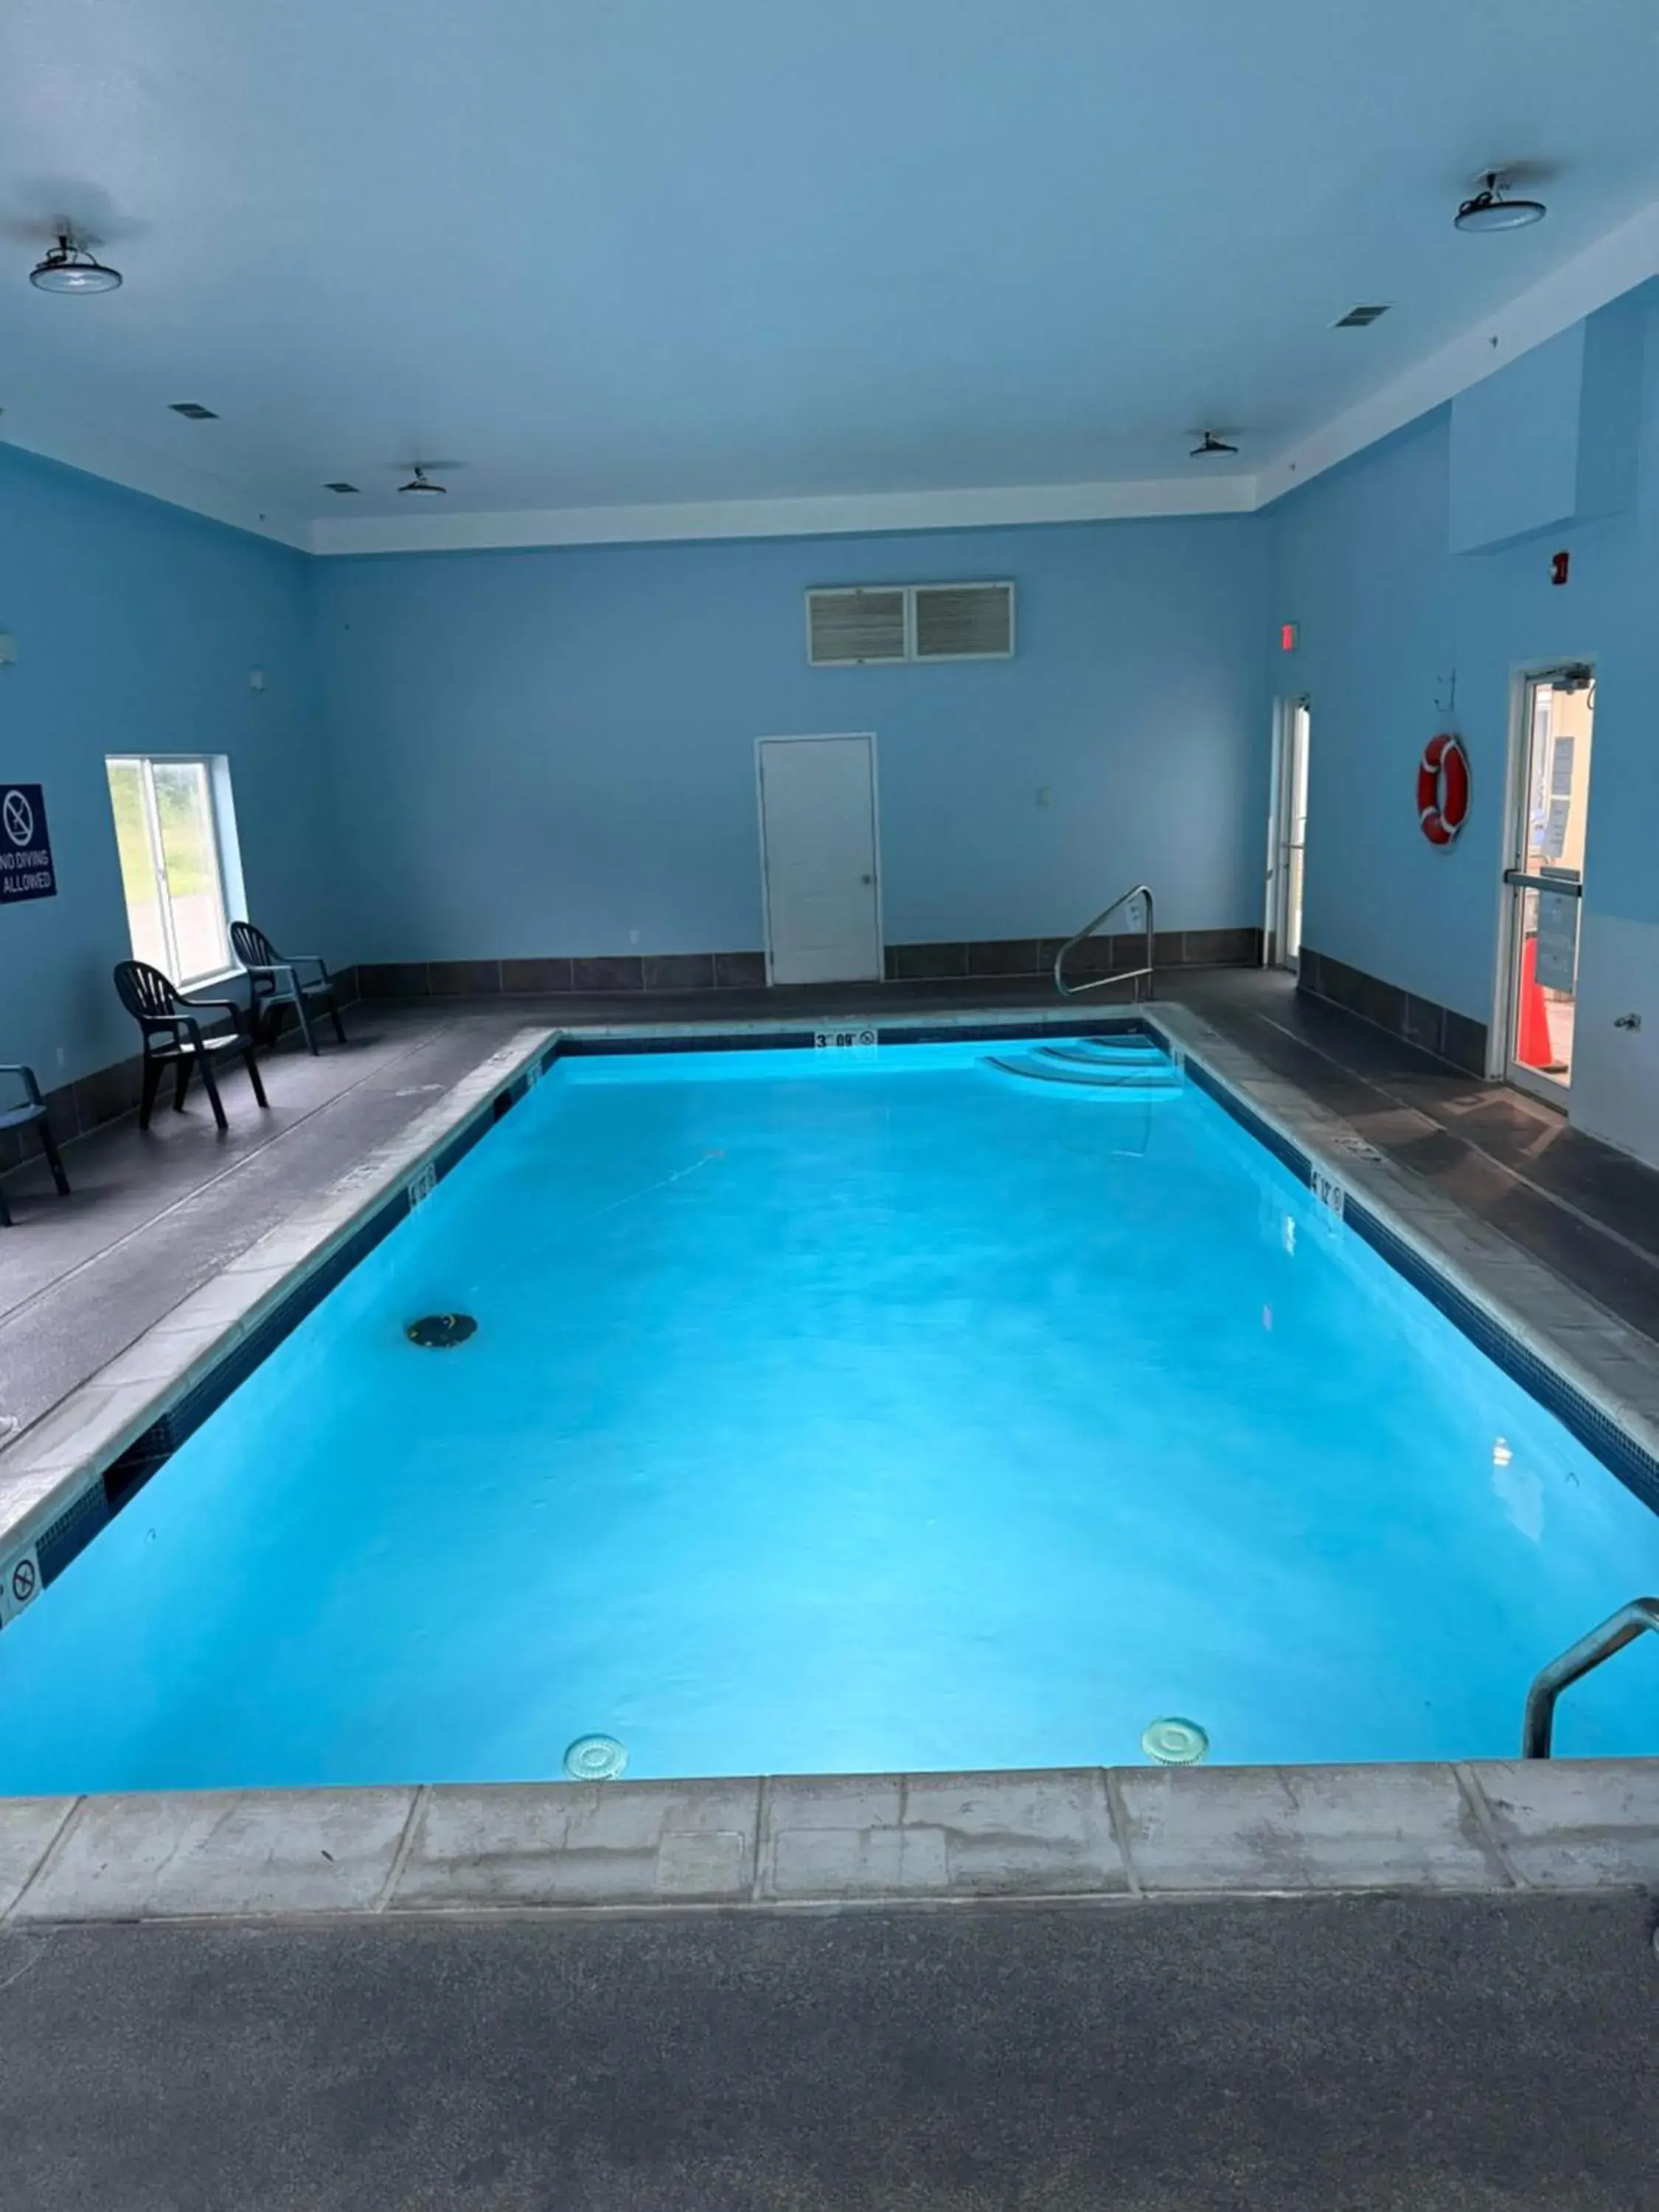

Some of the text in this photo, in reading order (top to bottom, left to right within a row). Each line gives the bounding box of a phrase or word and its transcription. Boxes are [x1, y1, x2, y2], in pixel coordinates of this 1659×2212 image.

[0, 849, 49, 869] NO DIVING
[4, 872, 51, 894] ALLOWED
